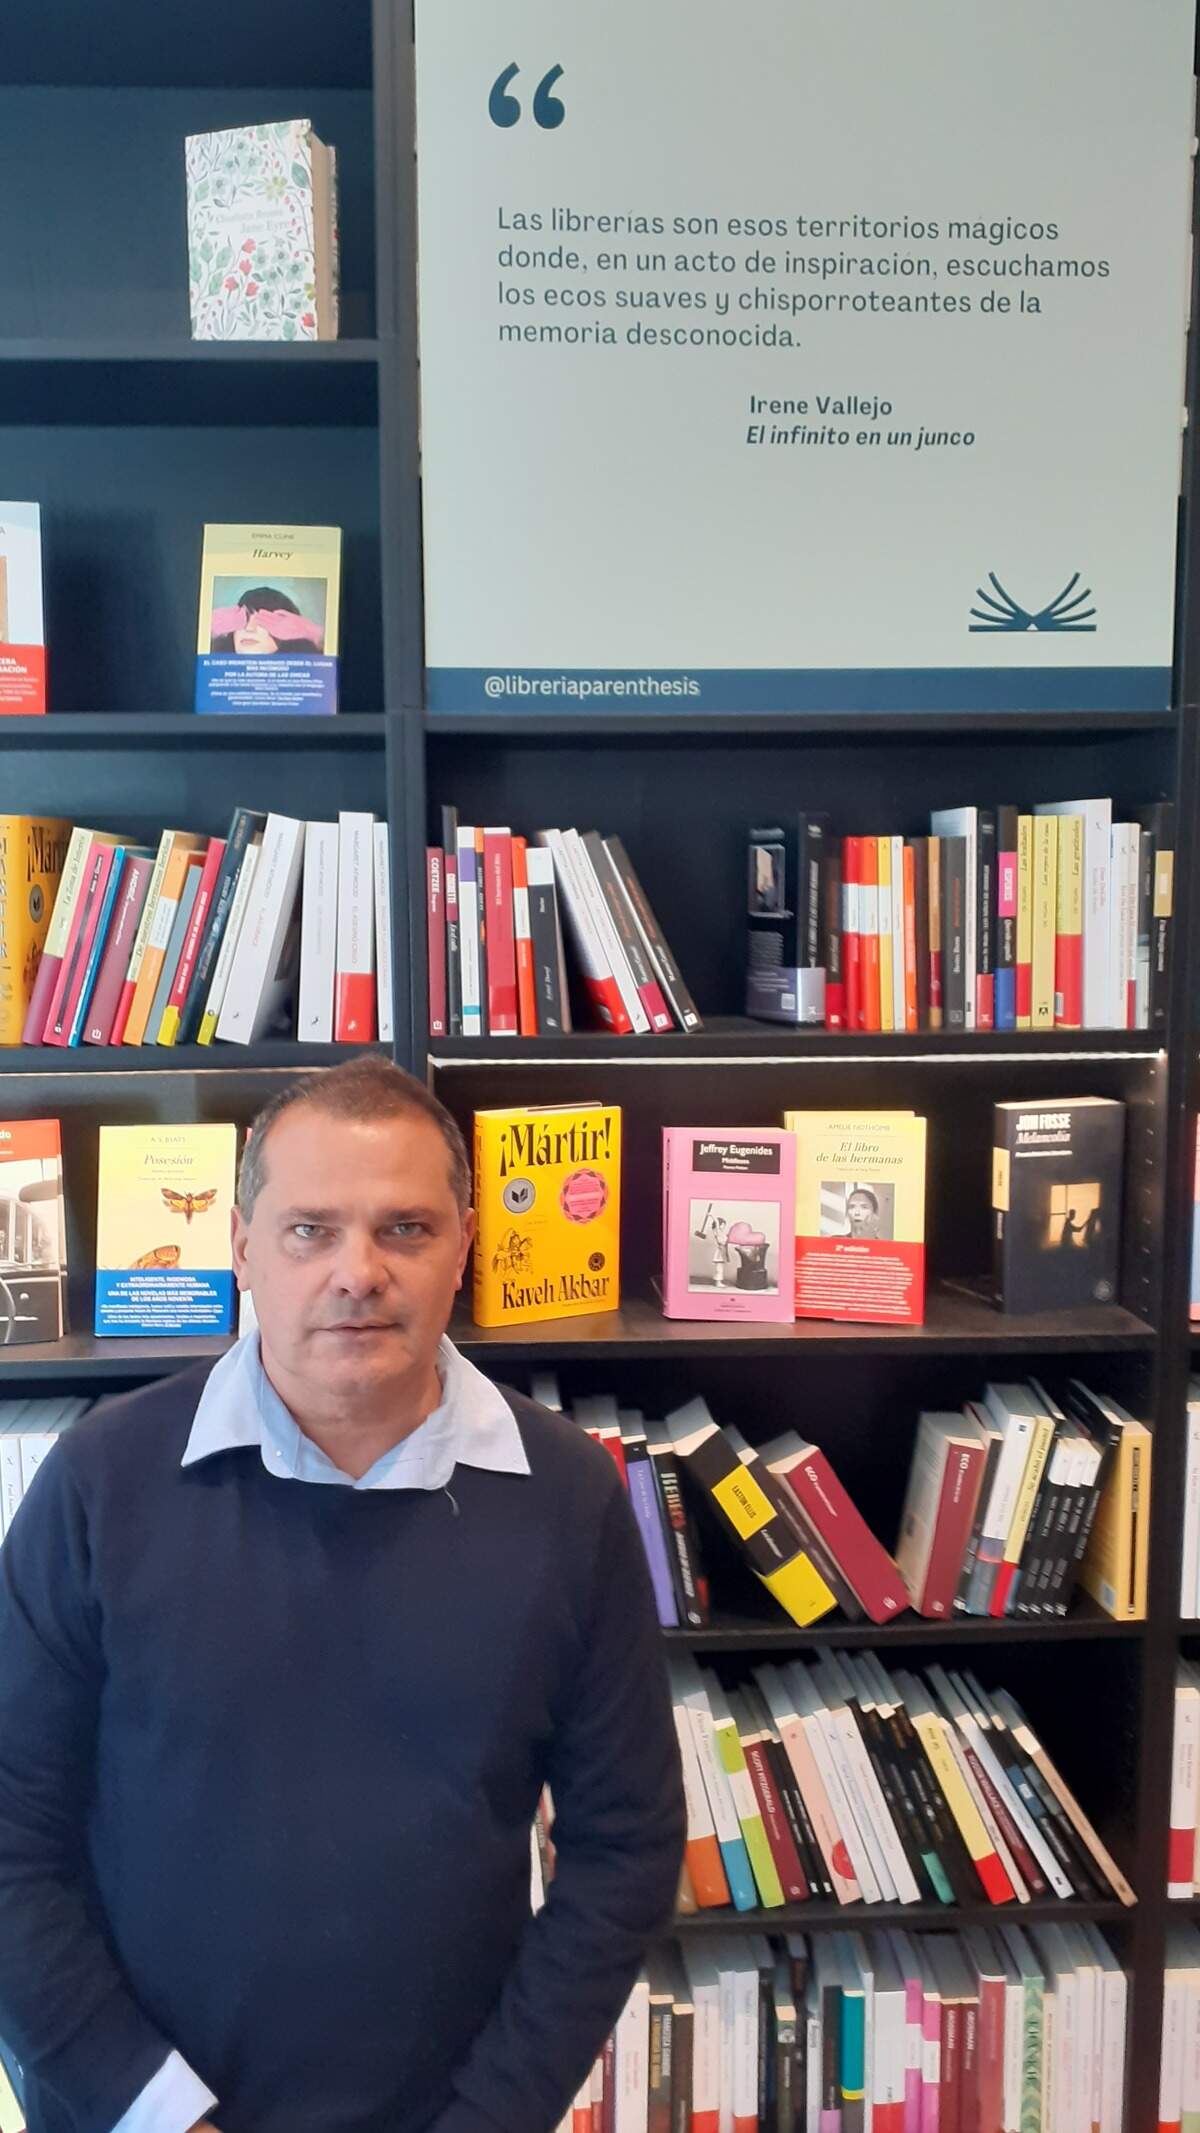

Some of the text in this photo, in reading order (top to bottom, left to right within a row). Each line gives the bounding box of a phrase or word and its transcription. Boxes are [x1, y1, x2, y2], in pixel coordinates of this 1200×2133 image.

[499, 207, 1059, 245] Las librerías son esos territorios mágicos
[499, 245, 1110, 280] donde, en un acto de inspiración, escuchamos
[499, 281, 1042, 316] los ecos suaves y chisporroteantes de la
[499, 321, 801, 347] memoria desconocida.
[750, 395, 893, 421] Irene Vallejo
[746, 425, 976, 451] El infinito en un junco
[252, 548, 293, 560] Harvey
[484, 675, 701, 699] @libreriaparenthesis
[430, 857, 439, 892] COETZEE
[1040, 1113, 1072, 1130] FOSSE
[500, 1117, 612, 1177] ¡Mártir!
[699, 1144, 773, 1157] Jeffrey Eugenides
[816, 1152, 904, 1165] de las hermanas
[840, 1142, 880, 1152] El libro
[502, 1273, 610, 1310] Kaveh Akbar
[803, 1464, 819, 1483] ECO
[958, 1452, 971, 1469] ECO
[730, 1484, 757, 1520] EASTON ELLIS
[755, 1771, 776, 1814] FITZGERALD
